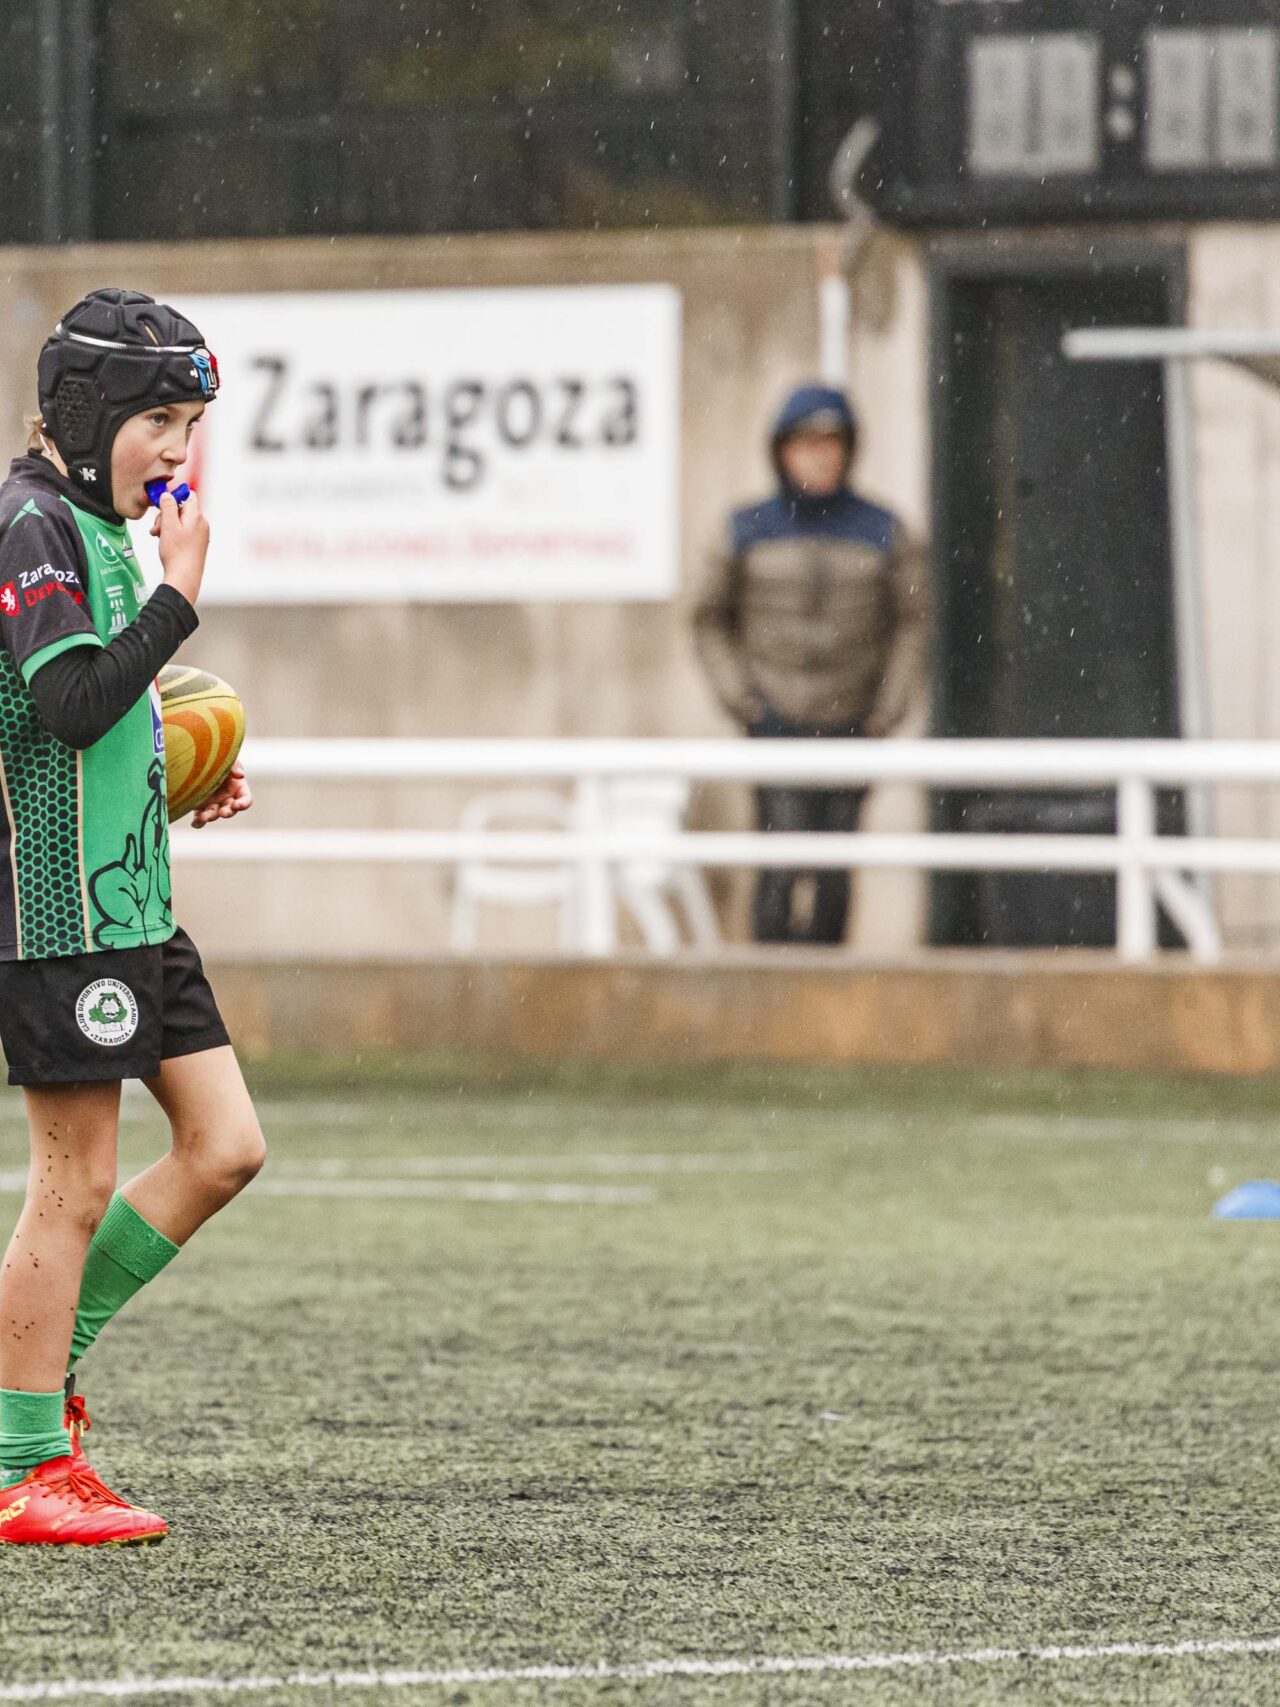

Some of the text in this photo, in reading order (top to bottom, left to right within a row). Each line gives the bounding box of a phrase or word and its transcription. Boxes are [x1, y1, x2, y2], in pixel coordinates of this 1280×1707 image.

[251, 354, 638, 491] Zaragoza
[18, 563, 80, 589] Zaraoz
[78, 980, 106, 1011] DEPORTIVO
[78, 1013, 90, 1033] CLUB
[93, 1032, 130, 1044] ZARAGOZA
